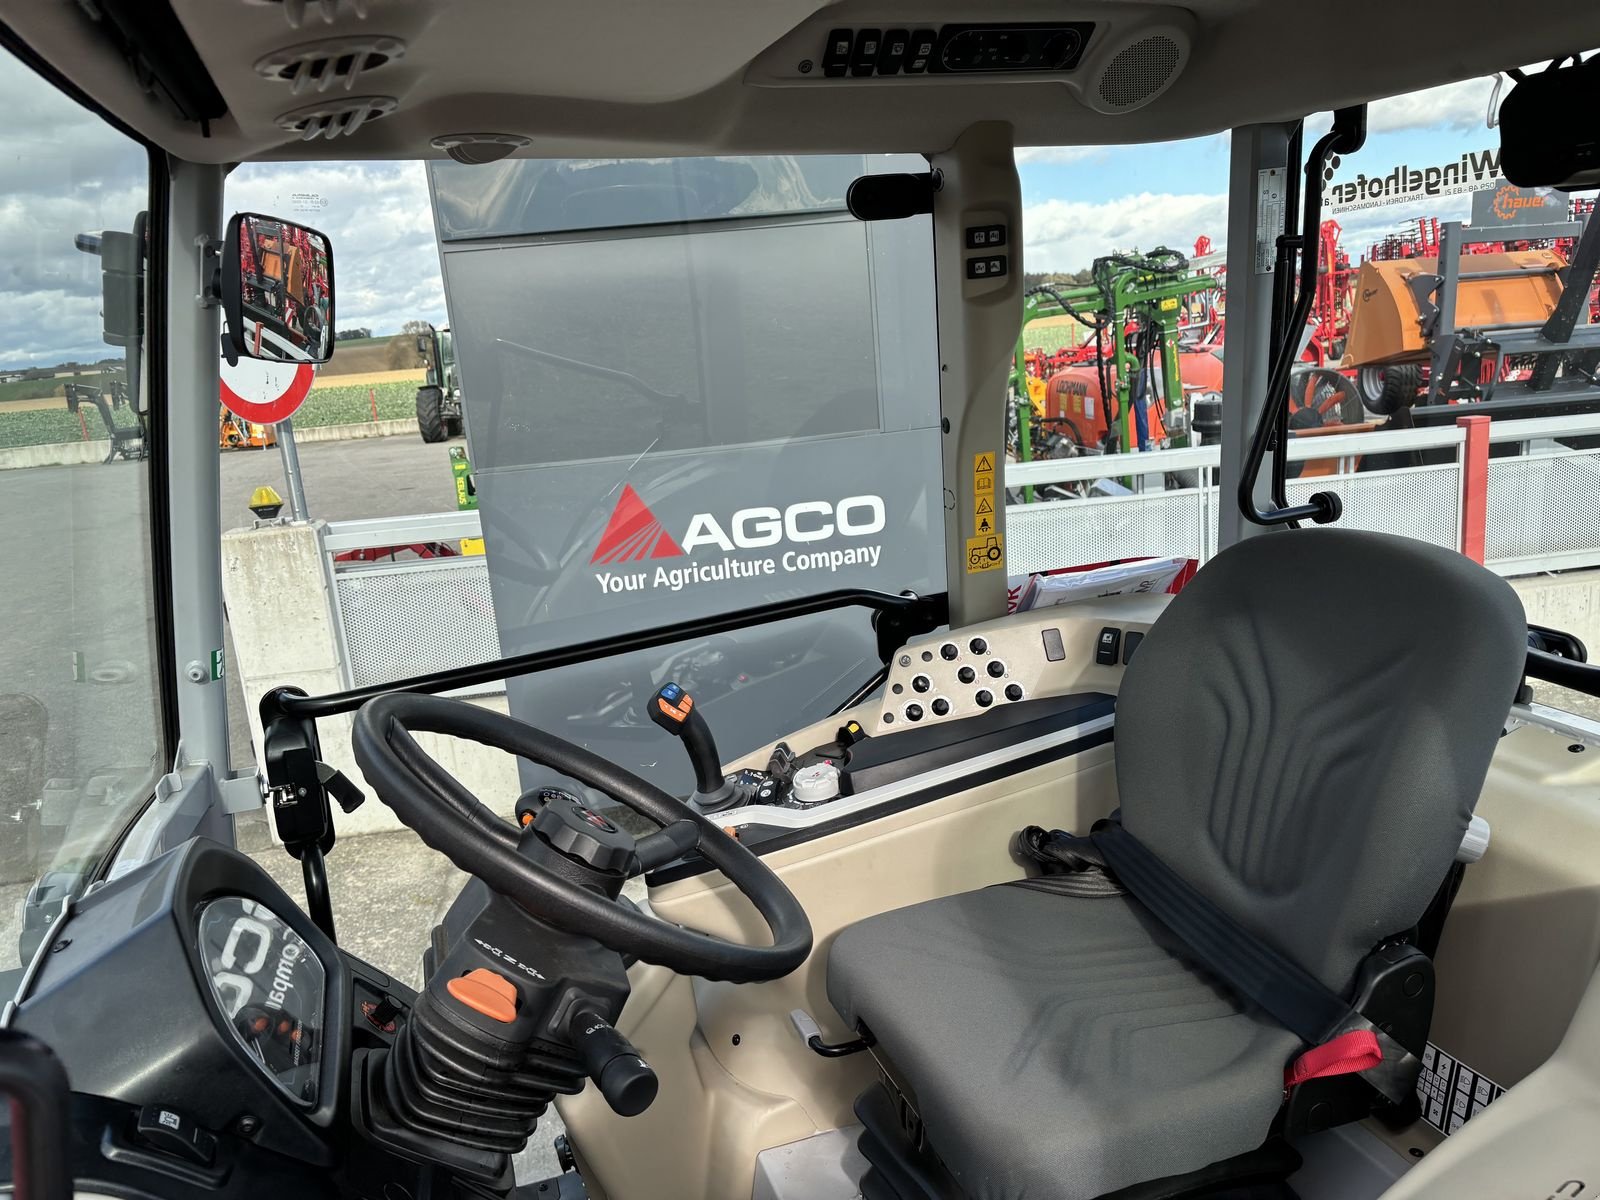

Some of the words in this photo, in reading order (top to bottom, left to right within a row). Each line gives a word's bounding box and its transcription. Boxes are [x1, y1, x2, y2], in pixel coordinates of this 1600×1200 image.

[681, 495, 886, 555] AGCO
[595, 571, 647, 594] Your
[653, 557, 776, 591] Agriculture
[782, 545, 882, 572] Company
